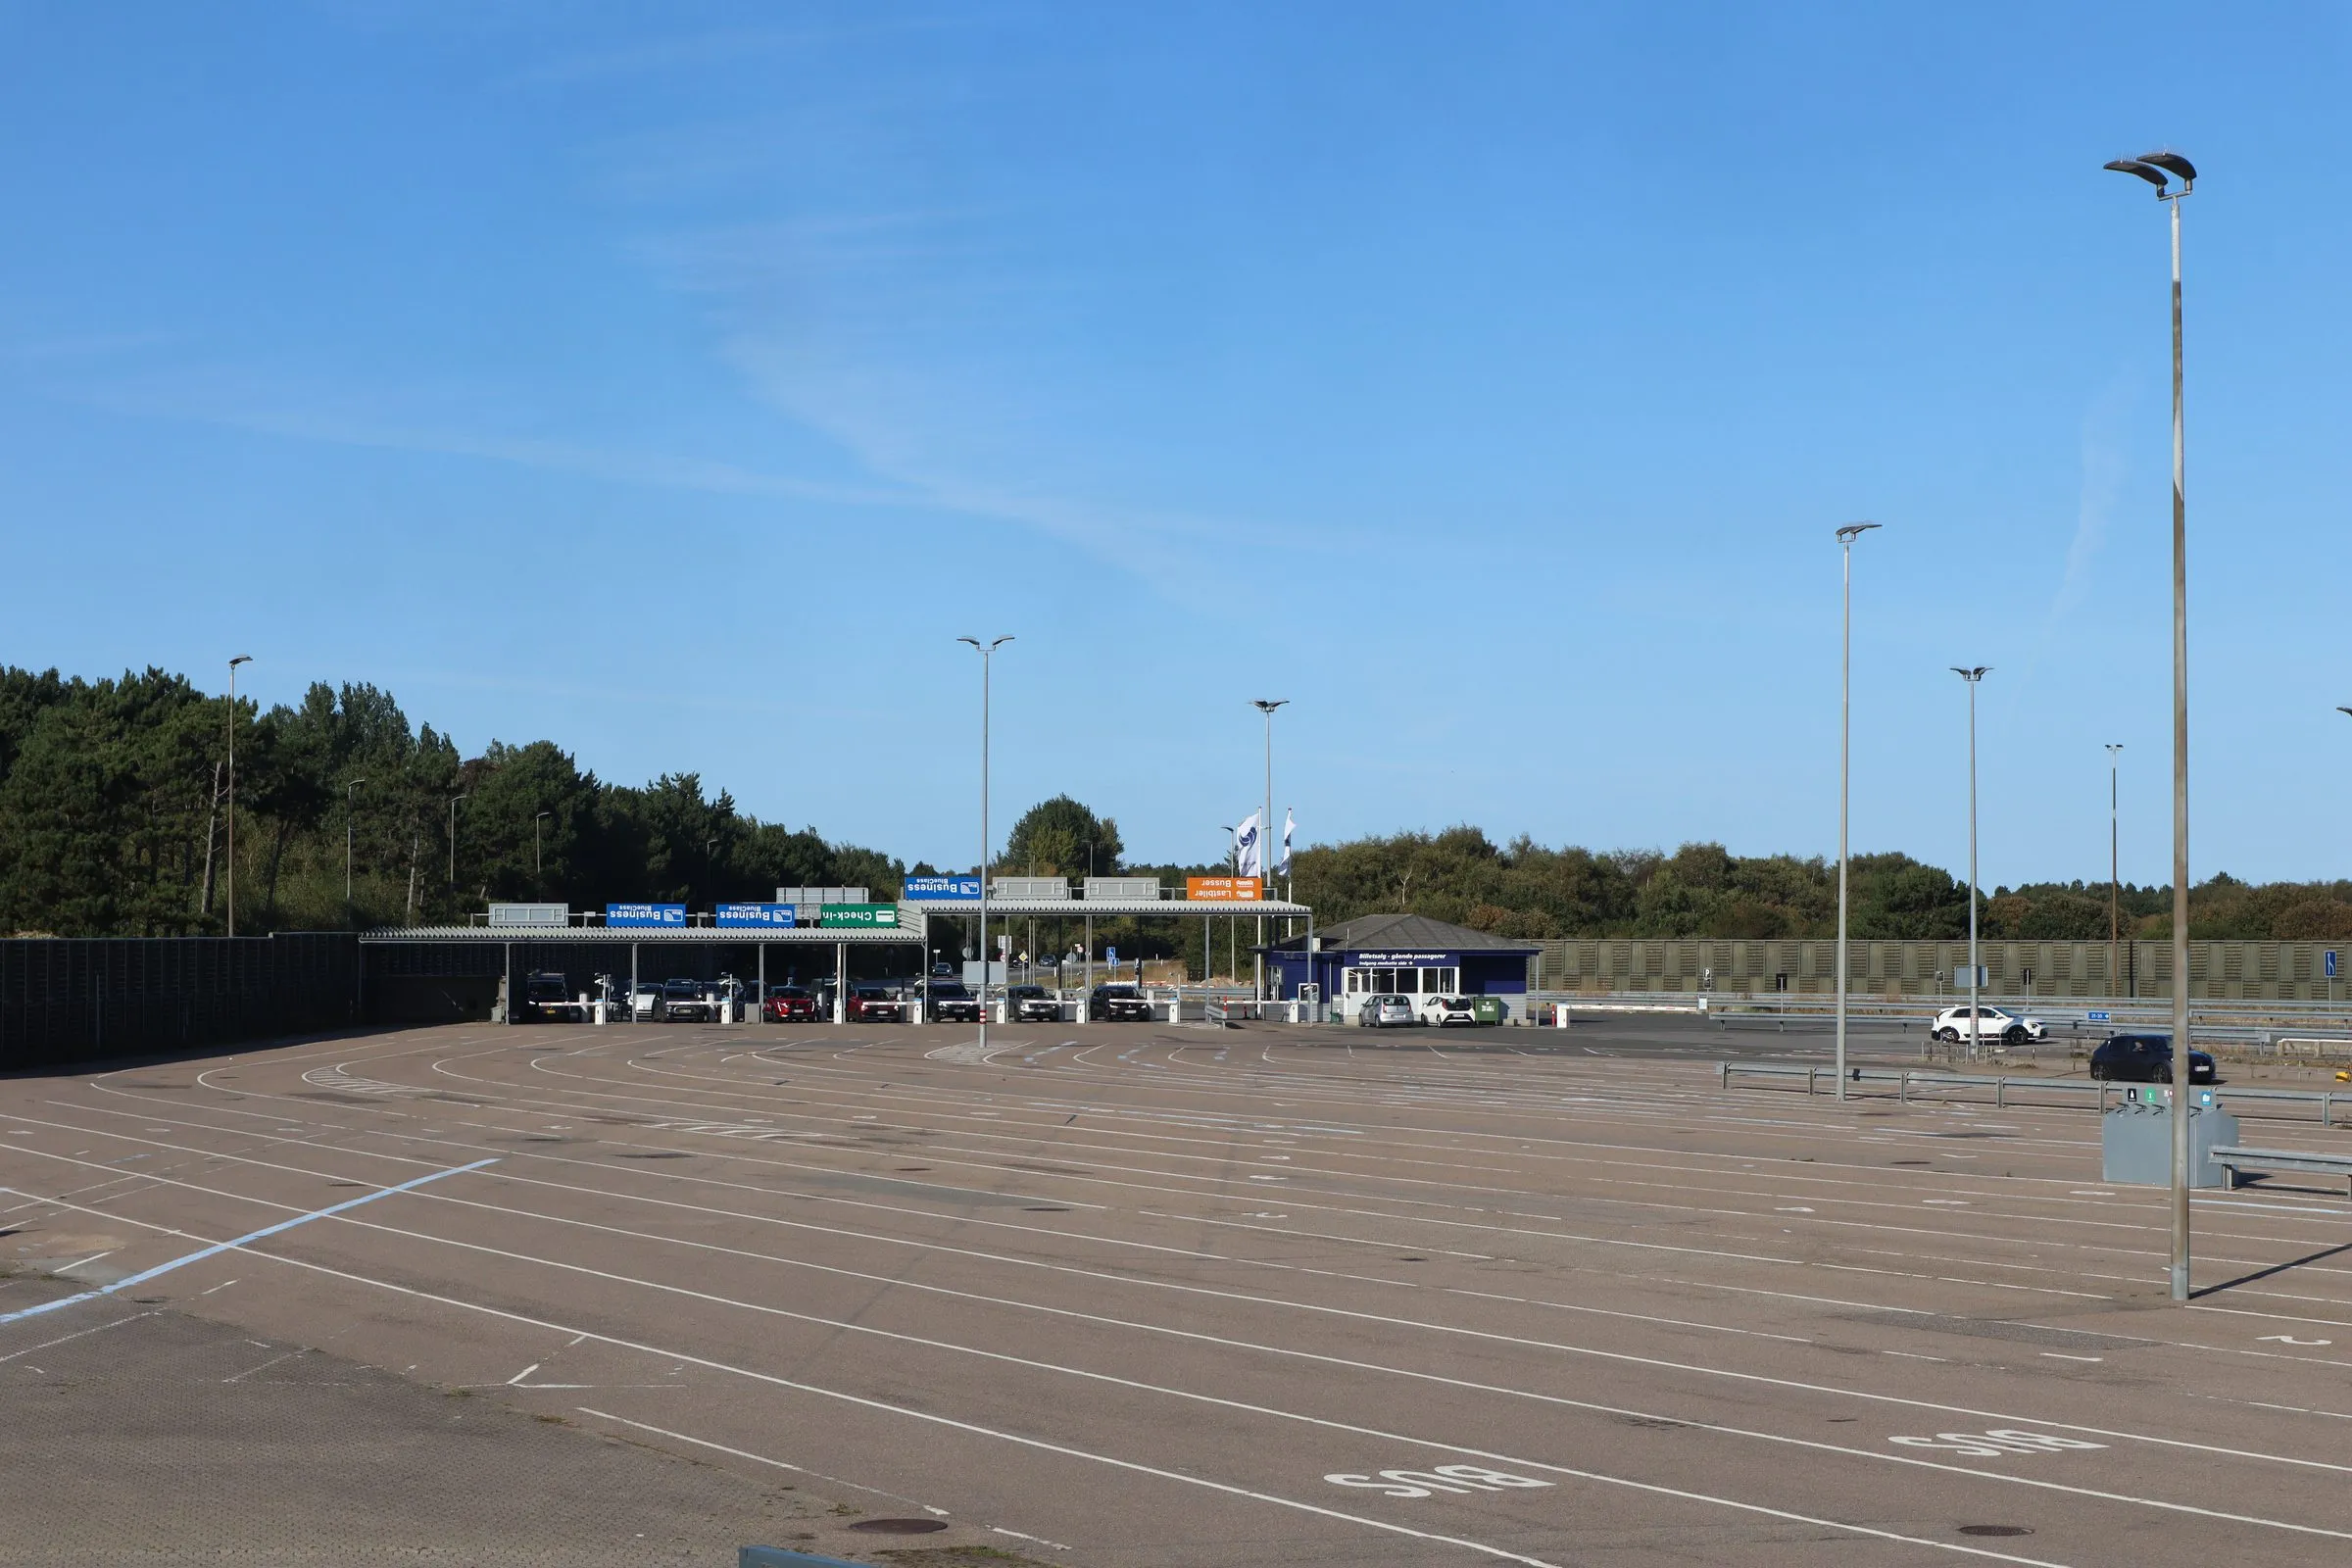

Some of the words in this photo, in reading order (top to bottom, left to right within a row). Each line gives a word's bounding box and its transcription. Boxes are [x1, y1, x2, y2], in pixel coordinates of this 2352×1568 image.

[907, 884, 957, 893] Business
[610, 910, 661, 920] Business
[719, 911, 770, 920] Business
[822, 911, 872, 920] Check-in
[1887, 1429, 2110, 1456] BUS
[1323, 1464, 1557, 1497] BUS
